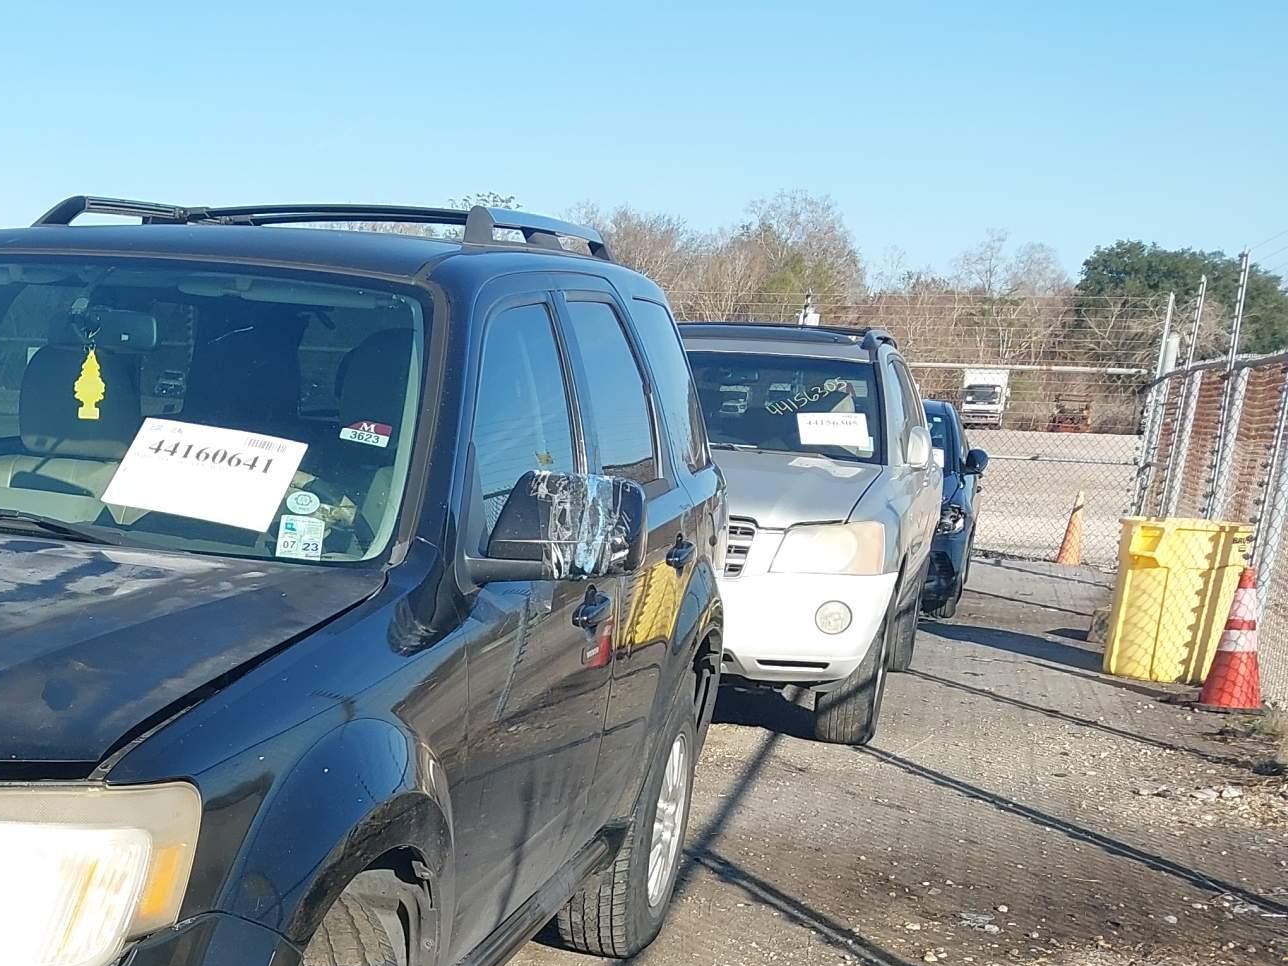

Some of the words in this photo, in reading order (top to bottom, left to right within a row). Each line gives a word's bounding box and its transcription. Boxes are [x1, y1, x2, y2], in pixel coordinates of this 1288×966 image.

[765, 376, 847, 416] 44156305
[358, 422, 377, 434] M
[349, 430, 380, 444] 3623
[148, 439, 273, 474] 44160641
[282, 540, 296, 549] 07
[302, 542, 319, 552] 23
